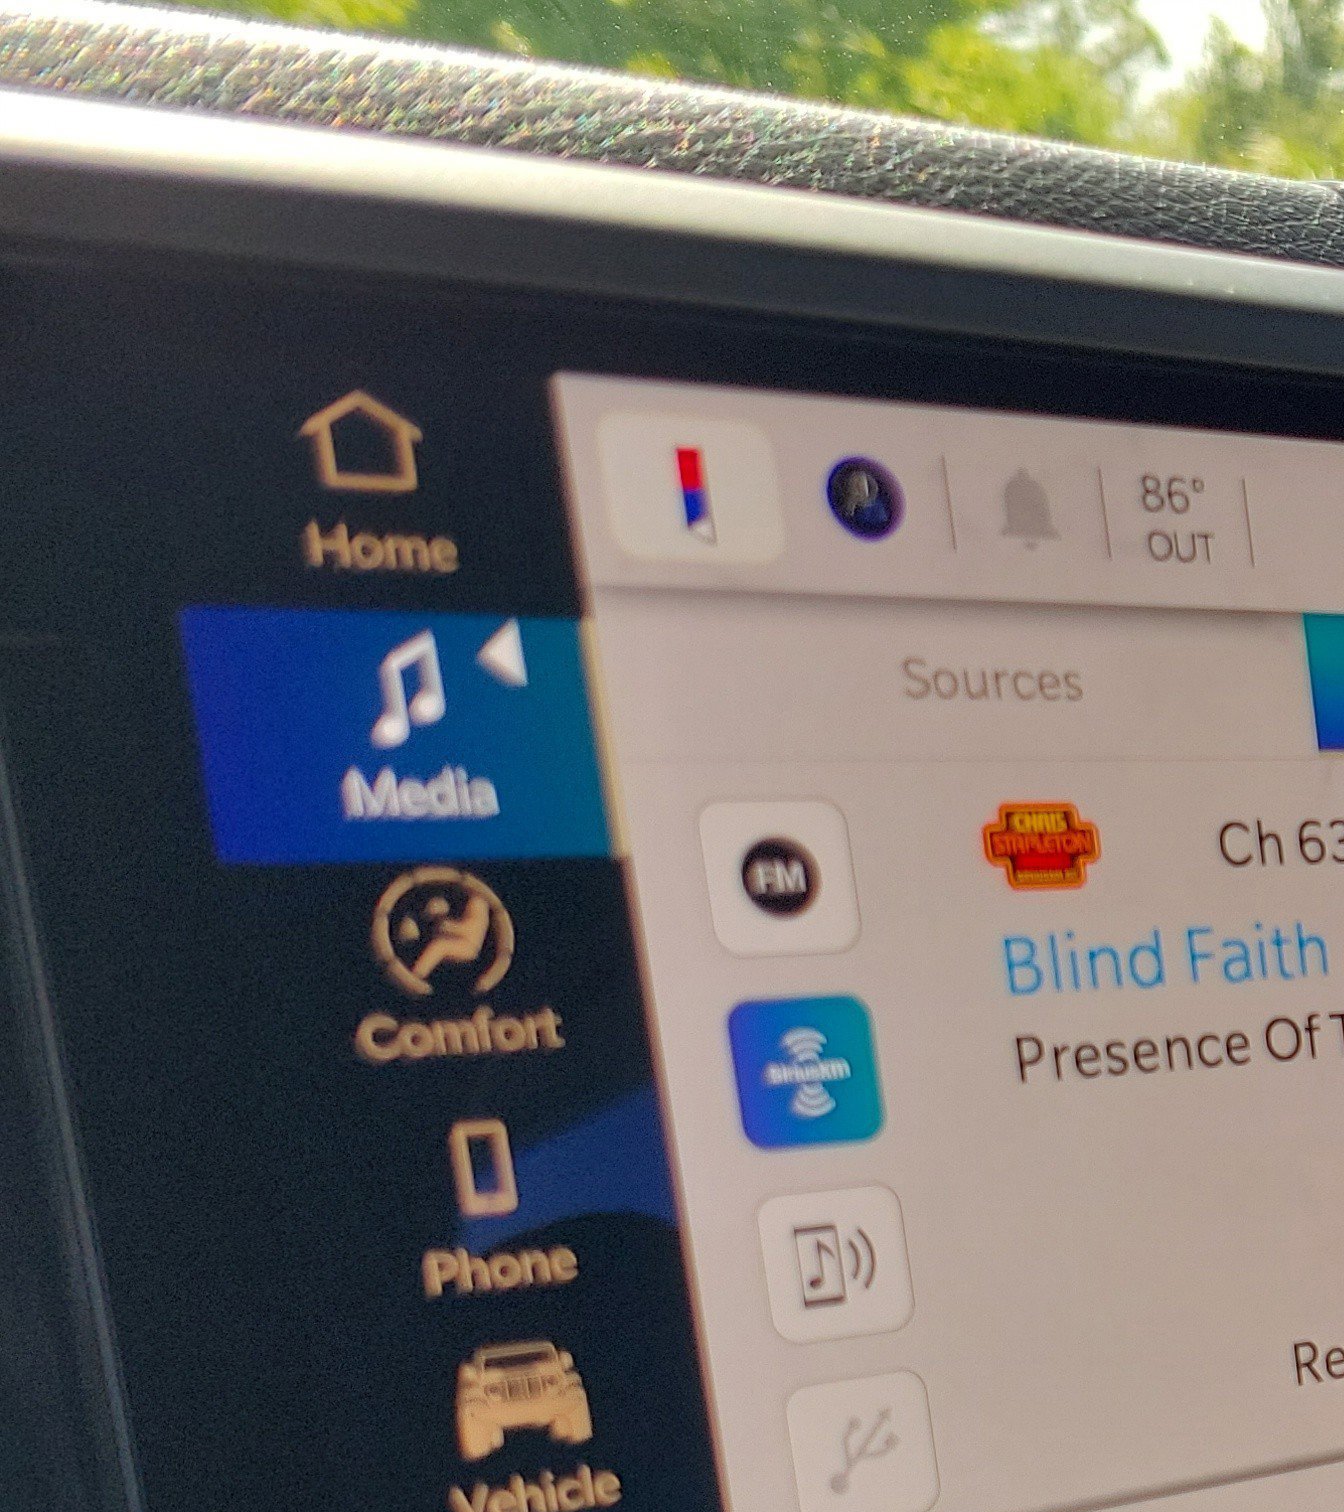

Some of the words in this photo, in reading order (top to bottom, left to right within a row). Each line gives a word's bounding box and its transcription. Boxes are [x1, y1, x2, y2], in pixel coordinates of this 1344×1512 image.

[304, 518, 459, 573] Home
[1148, 530, 1215, 564] OUT
[903, 655, 1084, 703] Sources
[342, 764, 500, 820] Media
[1219, 819, 1284, 868] Ch
[750, 865, 807, 894] FM
[1003, 926, 1167, 997] Blind
[1186, 921, 1330, 985] Faith
[355, 1006, 567, 1063] Comfort
[1014, 1027, 1251, 1084] Presence
[1265, 1014, 1322, 1063] Of
[422, 1245, 579, 1297] Phone
